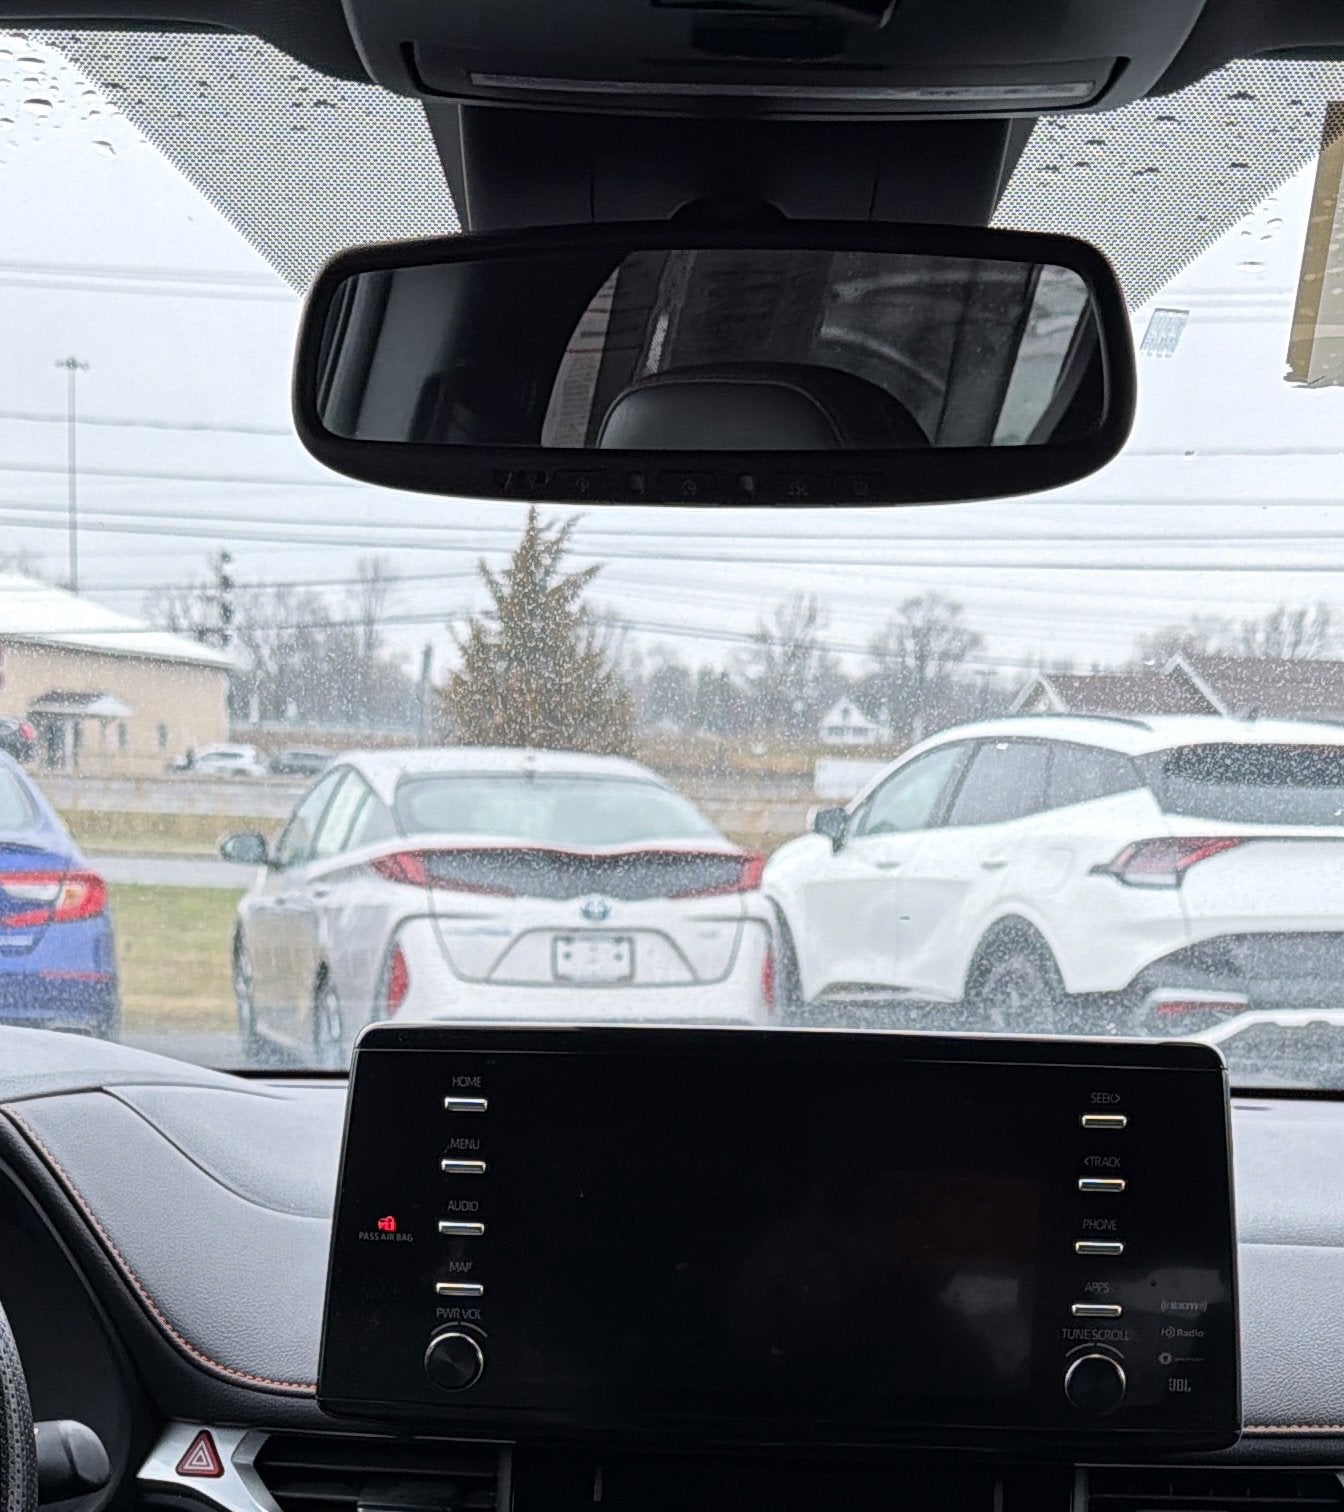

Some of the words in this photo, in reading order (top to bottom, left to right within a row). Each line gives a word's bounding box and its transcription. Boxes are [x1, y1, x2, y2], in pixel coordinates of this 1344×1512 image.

[452, 1076, 482, 1088] HOME
[449, 1137, 481, 1150] MENU
[447, 1200, 479, 1212] AUDIO
[1082, 1218, 1118, 1231] PHONE
[358, 1231, 380, 1241] PASS
[380, 1232, 395, 1241] AIR
[396, 1233, 414, 1242] BAG
[448, 1261, 473, 1273] MAP
[1084, 1281, 1110, 1293] APPS
[436, 1307, 461, 1319] PWR
[461, 1308, 482, 1320] VOL
[1060, 1328, 1090, 1340] TUNE
[1091, 1328, 1130, 1341] SCROLL
[1177, 1329, 1205, 1338] Radio
[1168, 1377, 1192, 1392] JBL
